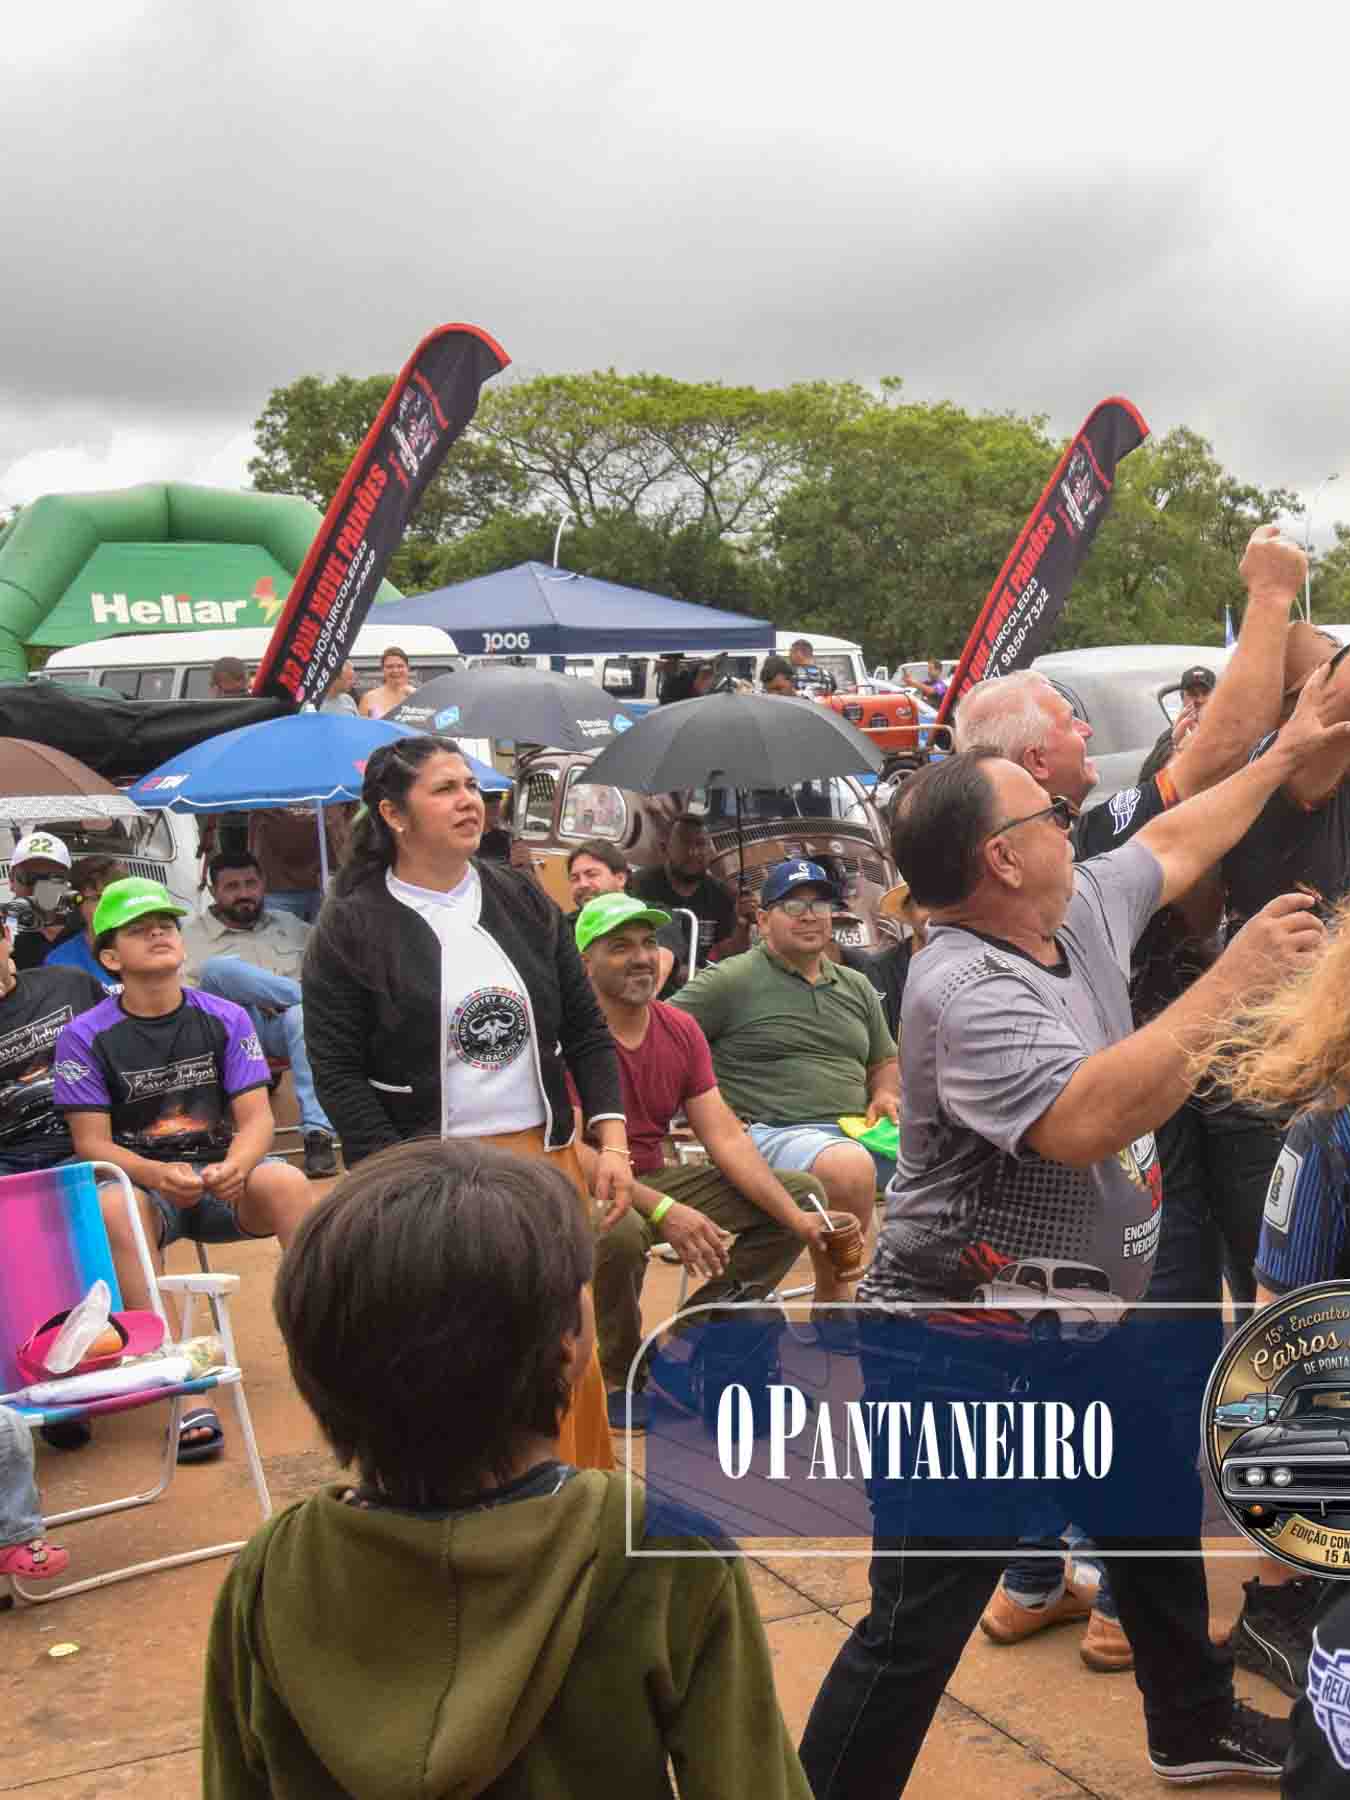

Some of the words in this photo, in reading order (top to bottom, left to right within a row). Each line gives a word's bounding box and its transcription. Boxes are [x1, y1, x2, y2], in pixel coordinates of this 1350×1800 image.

[91, 592, 247, 624] Heliar
[1001, 586, 1049, 667] 9850-7322
[327, 641, 340, 668] 67
[30, 837, 53, 853] 22
